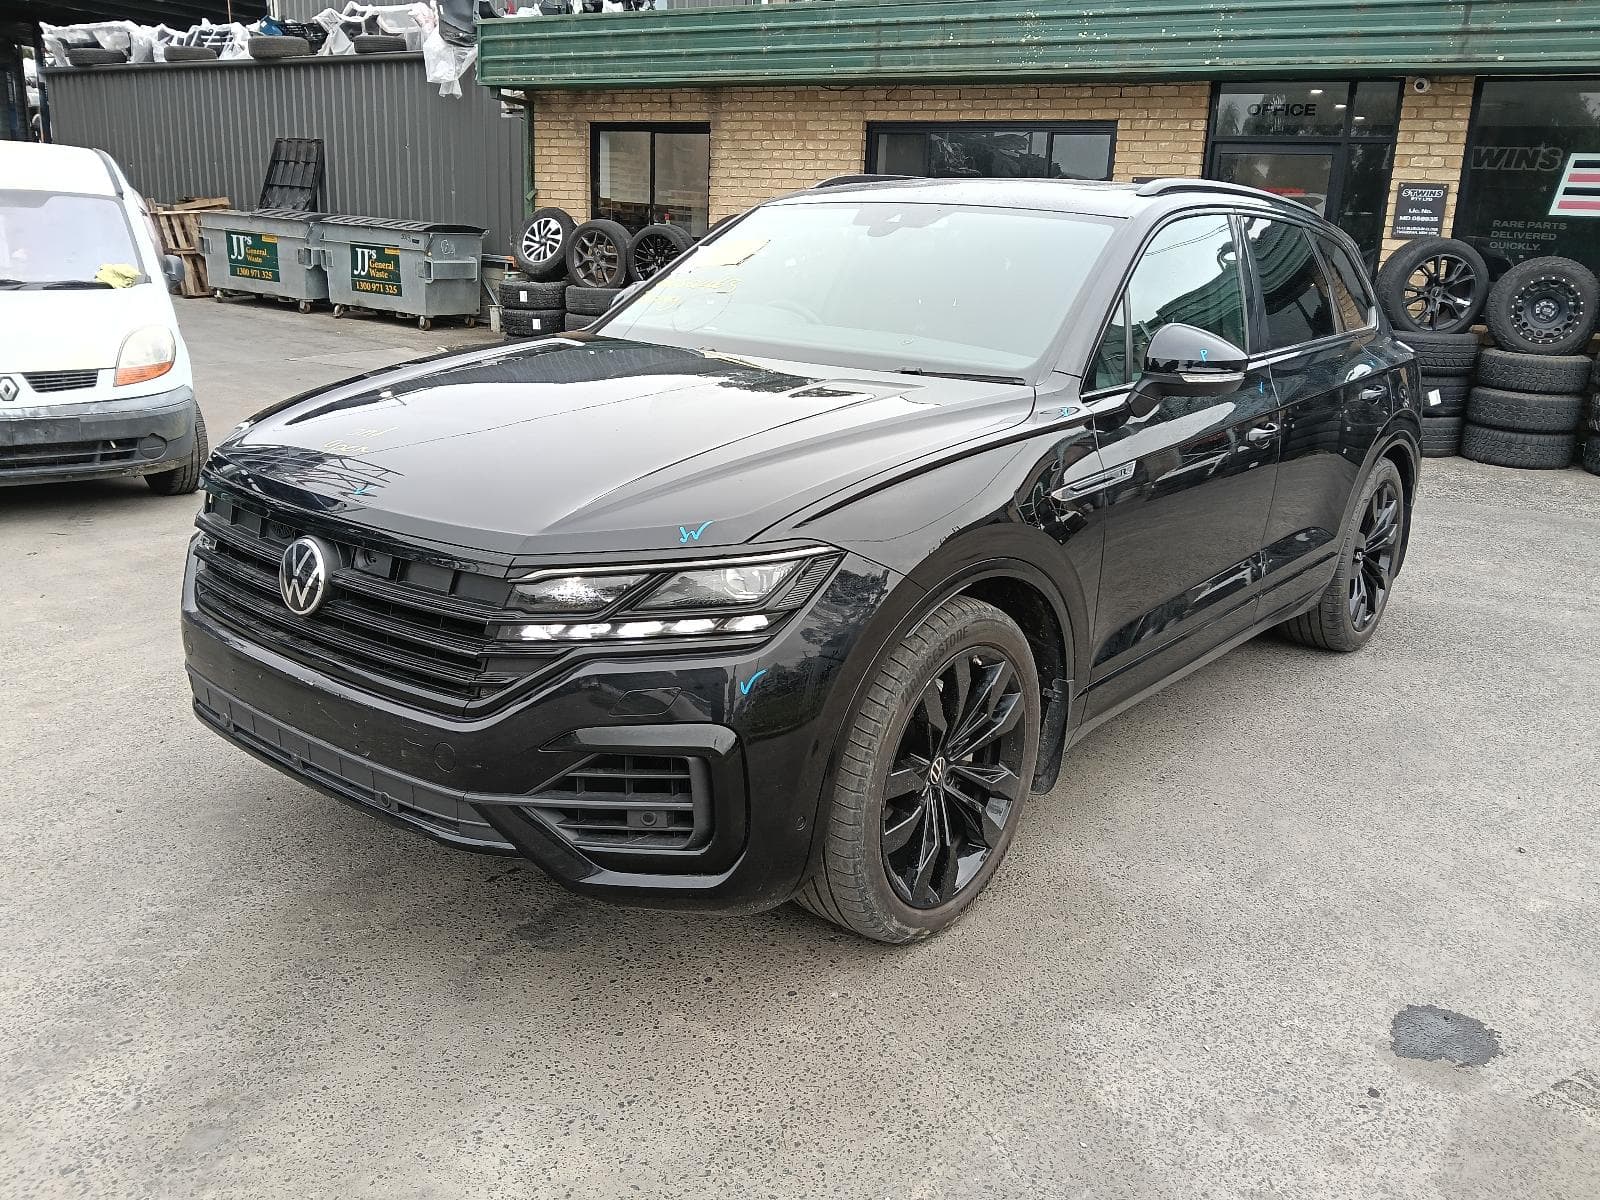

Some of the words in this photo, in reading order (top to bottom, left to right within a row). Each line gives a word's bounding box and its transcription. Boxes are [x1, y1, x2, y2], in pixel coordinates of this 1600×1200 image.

[1247, 103, 1317, 117] OFFICE
[1471, 146, 1563, 172] WINS
[1492, 219, 1525, 229] RARE
[1526, 221, 1568, 231] PARTS
[1490, 230, 1558, 241] DELIVERED
[1489, 241, 1541, 251] QUICKLY.
[369, 259, 394, 270] General
[236, 267, 250, 277] 1300
[250, 269, 261, 278] 971
[261, 270, 273, 280] 325
[369, 267, 389, 279] Waste
[356, 281, 371, 291] 1300
[371, 283, 384, 293] 971
[385, 284, 398, 294] 325
